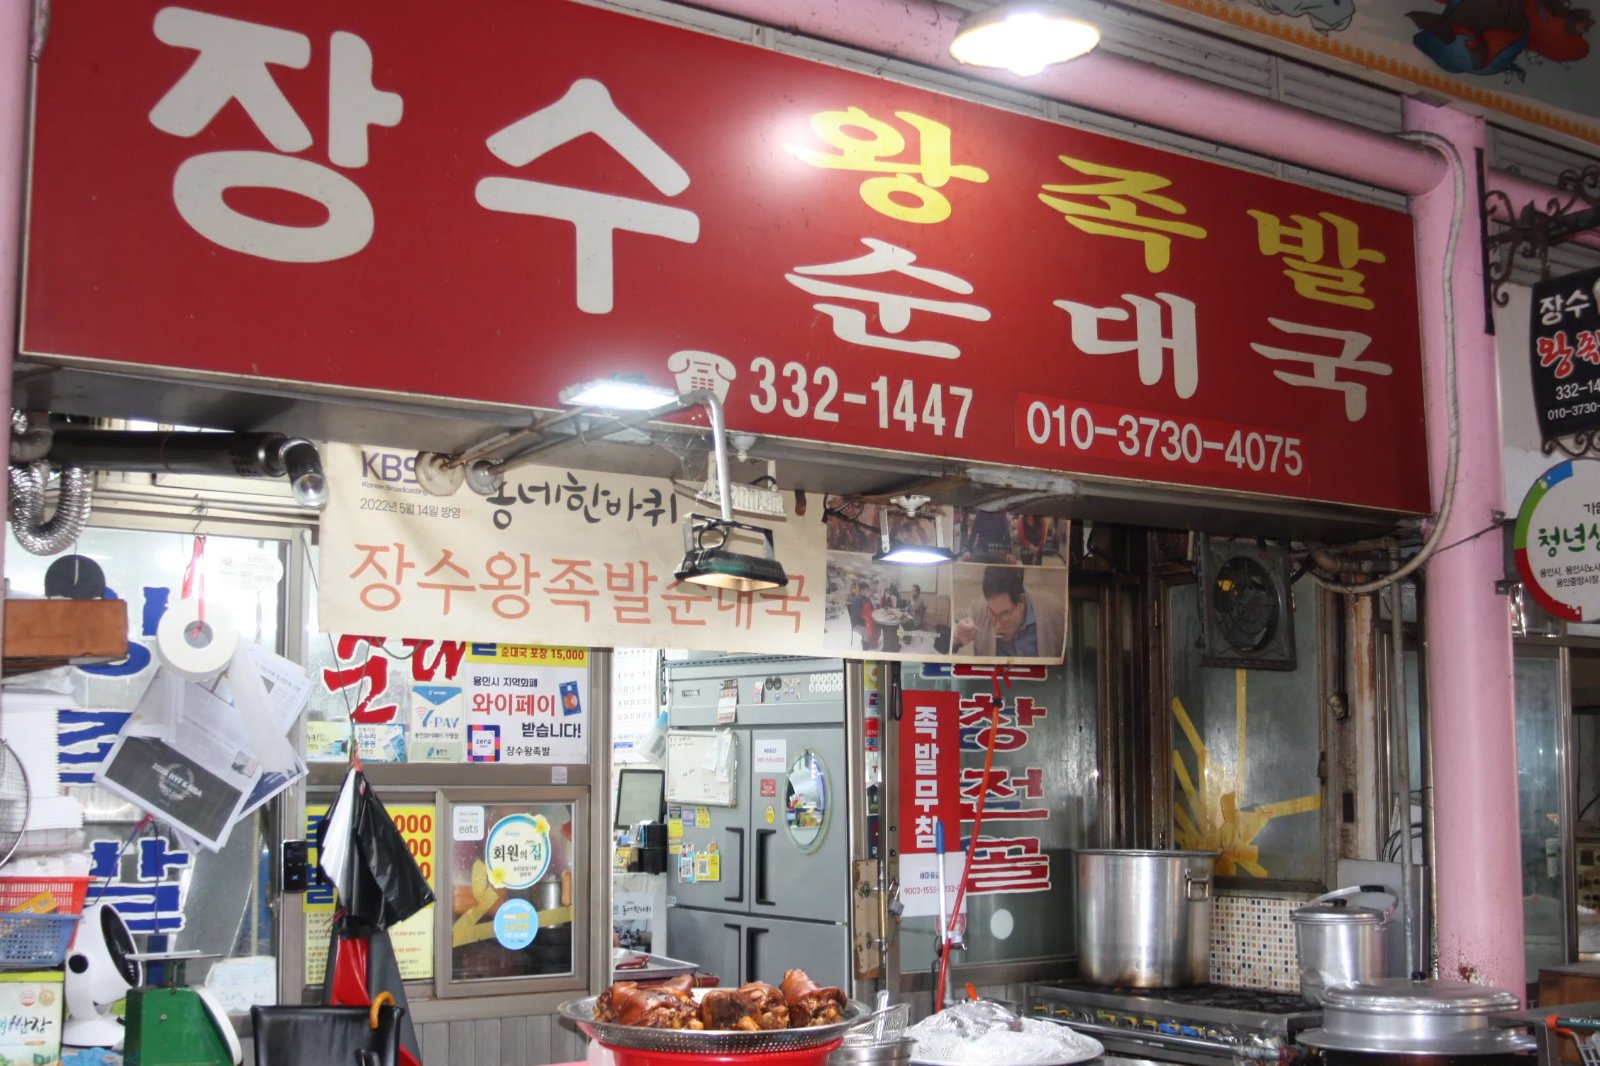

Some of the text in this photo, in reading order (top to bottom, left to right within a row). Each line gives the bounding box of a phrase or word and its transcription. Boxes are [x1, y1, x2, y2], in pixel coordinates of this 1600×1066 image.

[149, 5, 700, 314] 장수
[785, 105, 1386, 311] 왕족발
[1539, 289, 1590, 326] 장수
[785, 237, 1393, 422] 순대국
[1536, 330, 1600, 379] 왕족
[749, 356, 974, 440] 332-1447
[1026, 399, 1304, 477] 010-3730-4075
[361, 450, 417, 484] KBS
[359, 497, 461, 519] 2022년 5월 14일 방영
[551, 649, 584, 661] 15,000
[471, 692, 556, 717] 와이페이
[521, 722, 582, 739] 받습니다!
[506, 745, 550, 757] 장수왕족발
[914, 706, 939, 849] 족발무침
[458, 824, 479, 834] eats
[529, 842, 542, 861] 집
